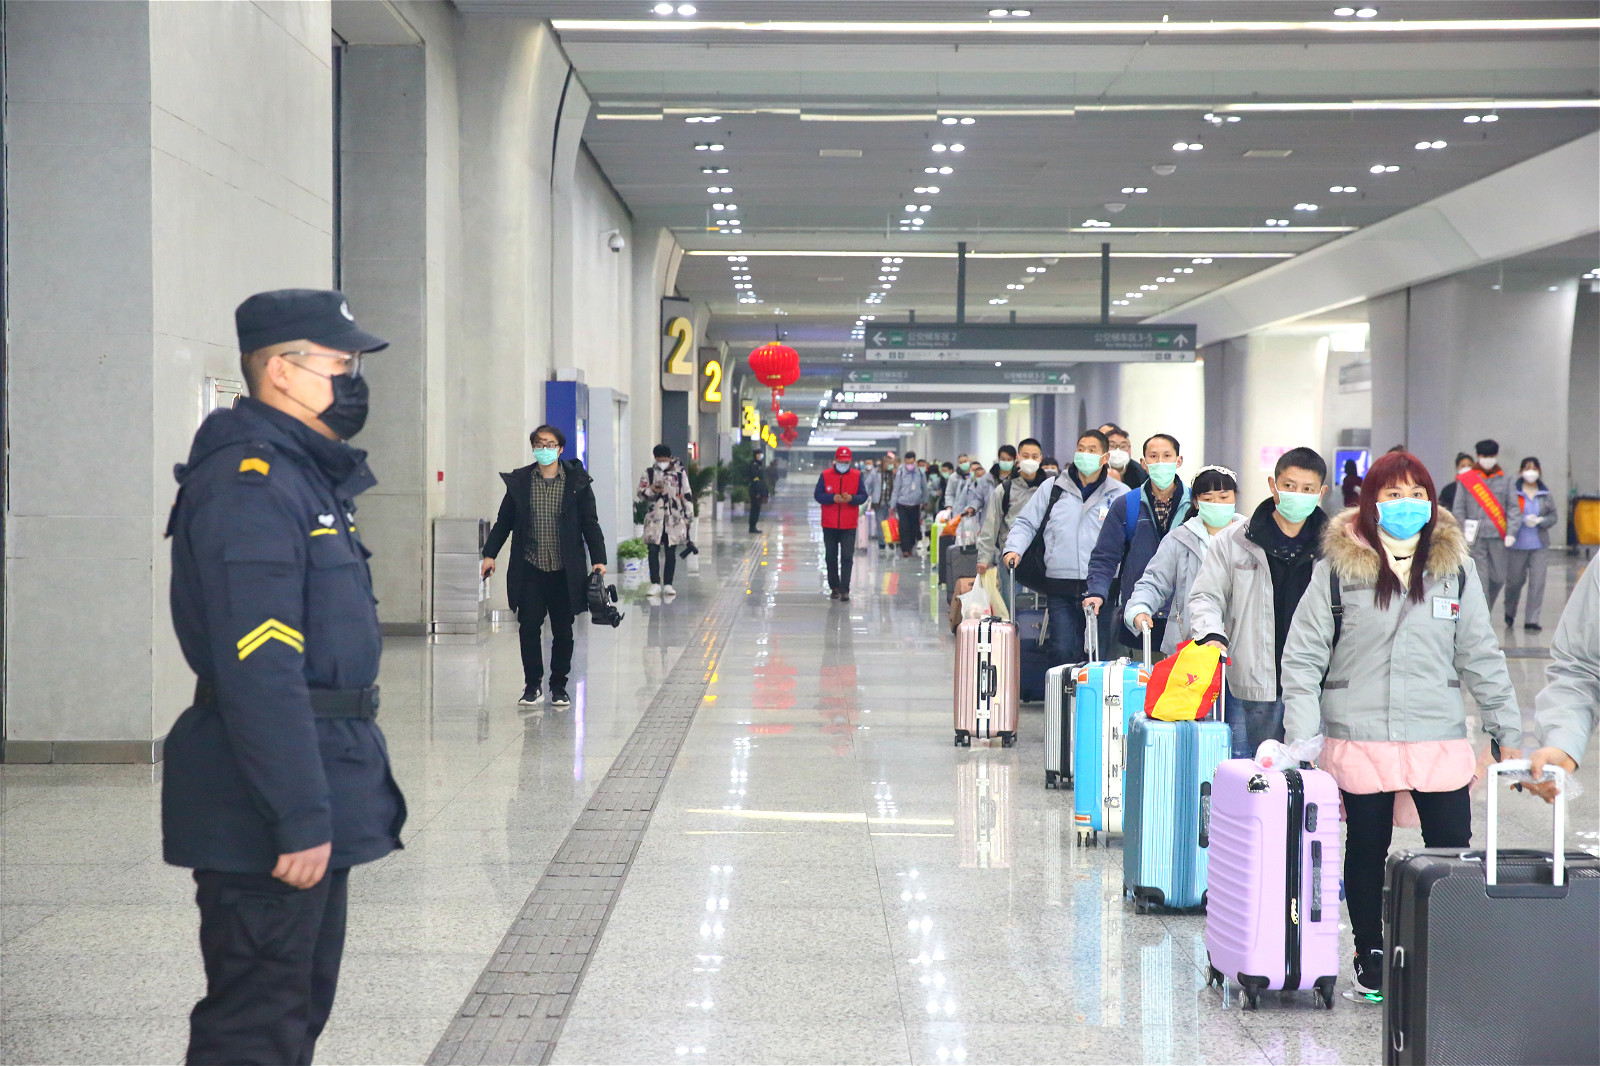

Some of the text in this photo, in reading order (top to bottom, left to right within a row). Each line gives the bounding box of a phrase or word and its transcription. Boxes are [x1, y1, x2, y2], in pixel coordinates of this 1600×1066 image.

[669, 317, 693, 375] 2
[705, 361, 722, 402] 2
[744, 405, 755, 430] 3
